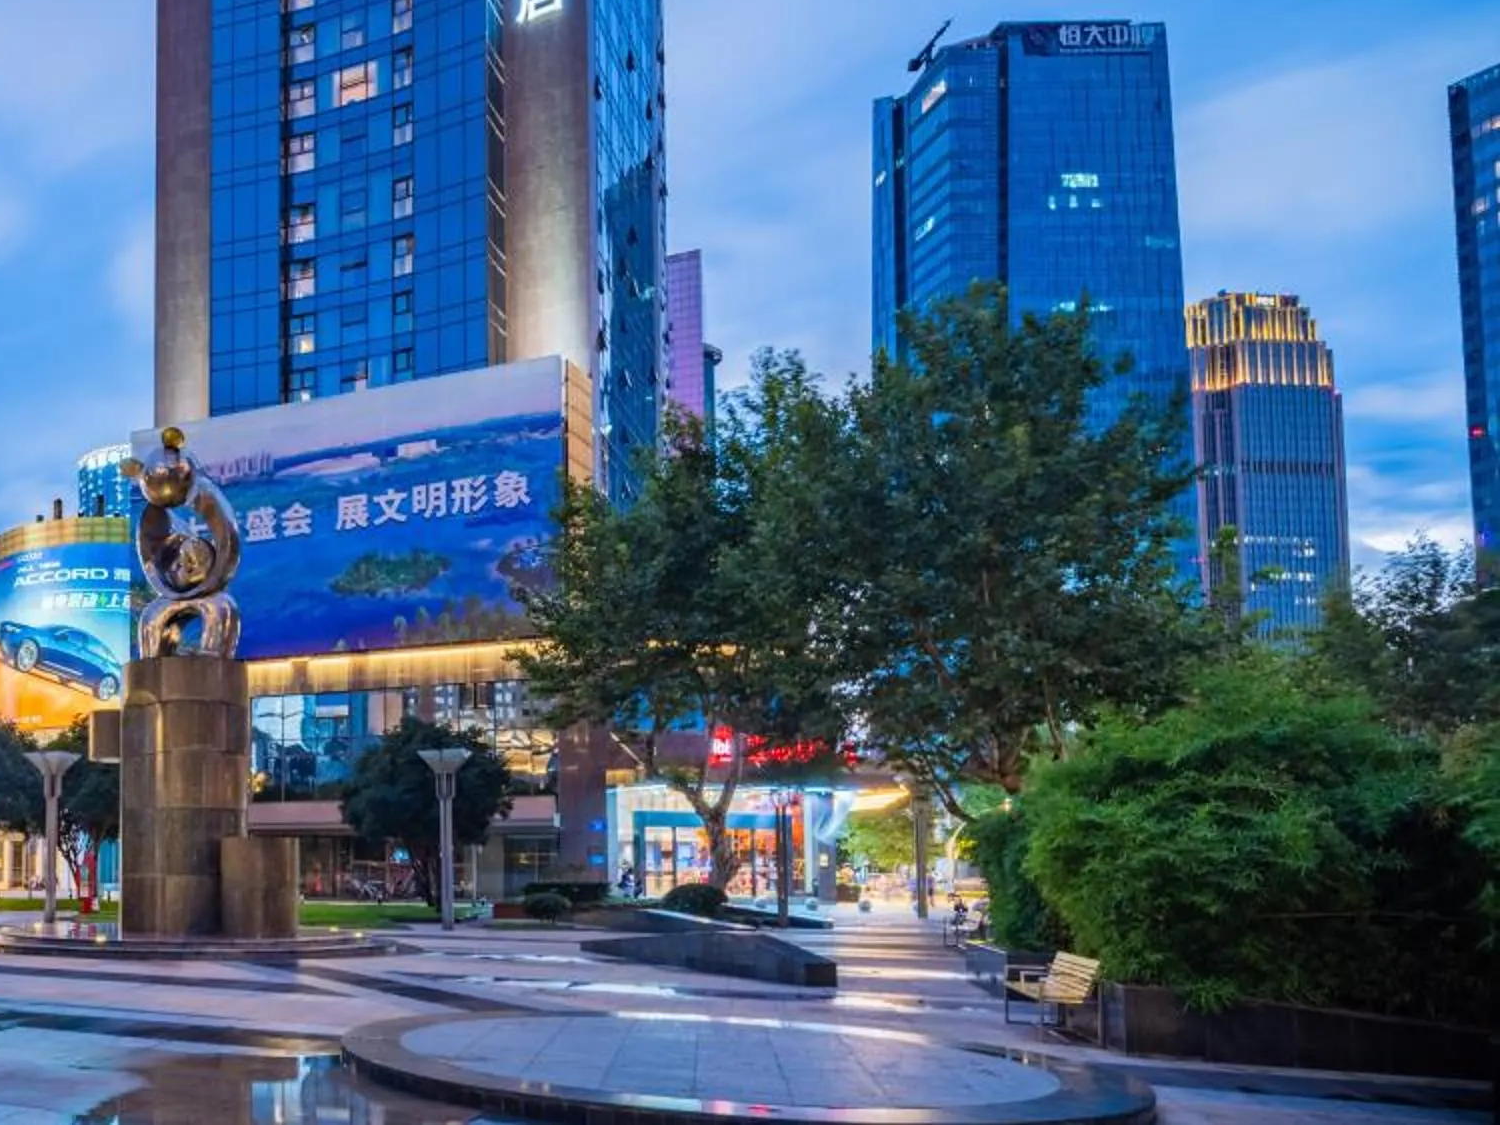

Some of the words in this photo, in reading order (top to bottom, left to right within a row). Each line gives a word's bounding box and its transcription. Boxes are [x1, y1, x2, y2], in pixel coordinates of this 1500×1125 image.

[335, 469, 532, 531] 展文明形象
[13, 567, 109, 588] ACCORD
